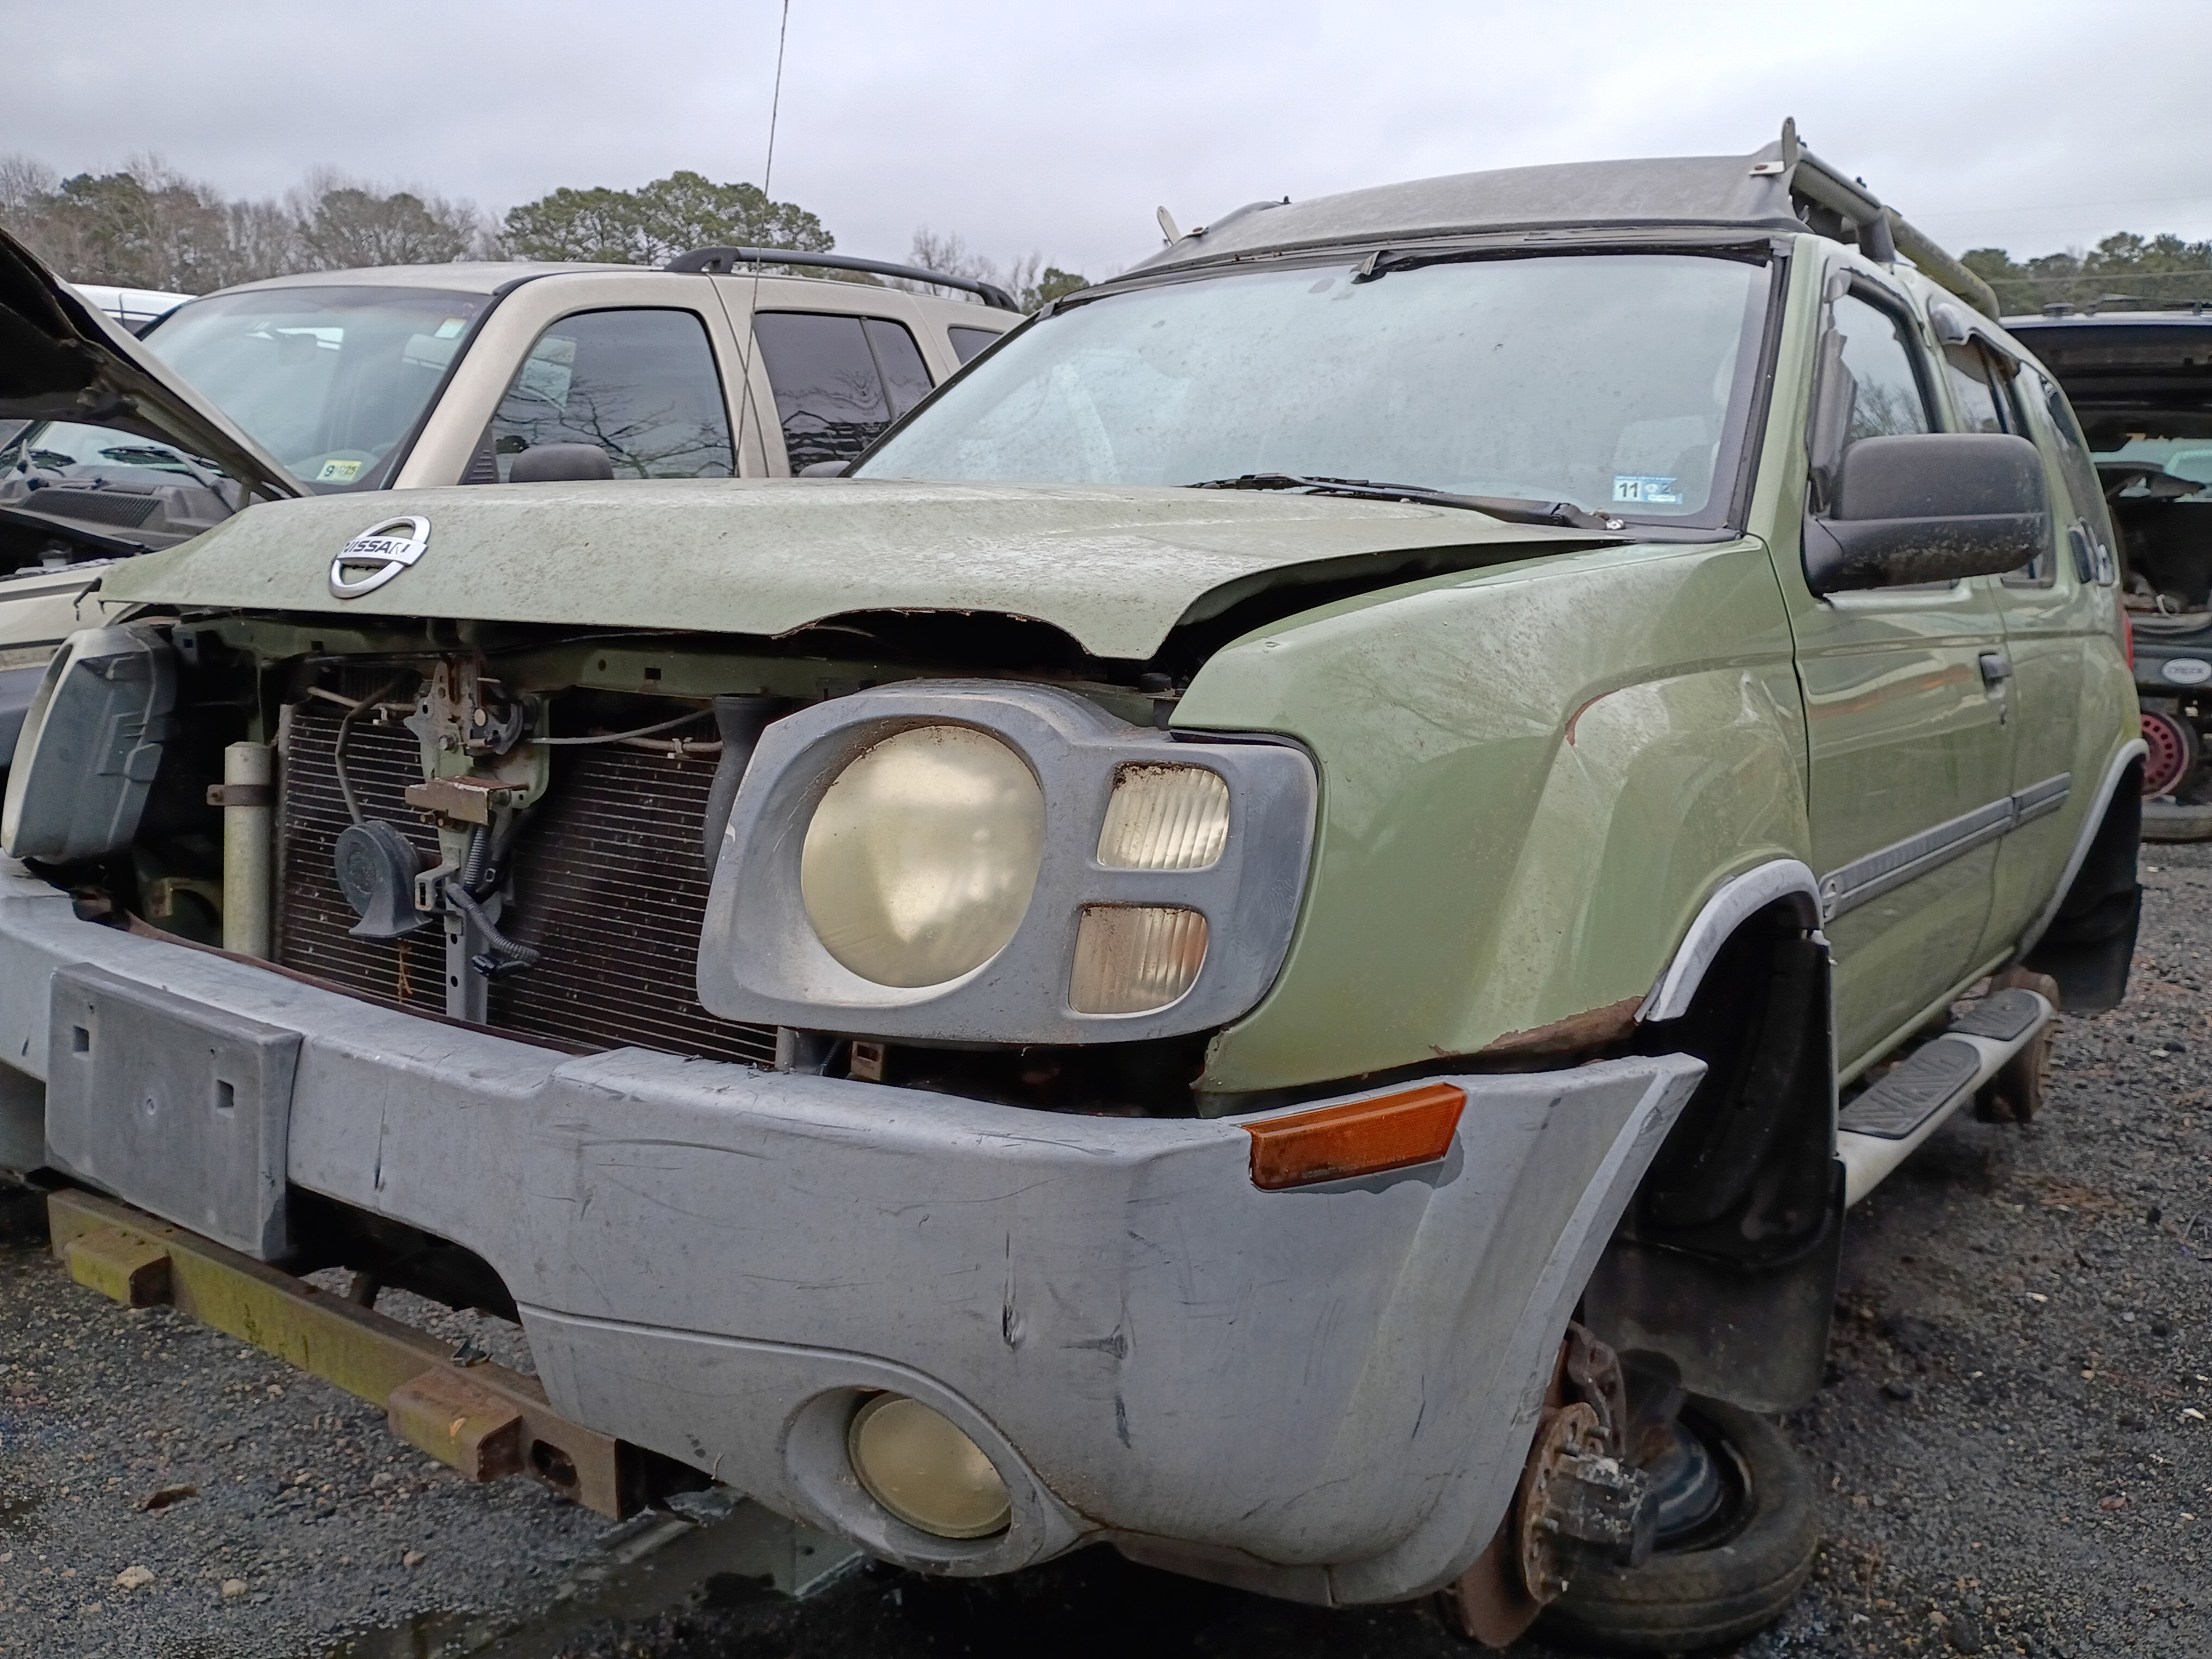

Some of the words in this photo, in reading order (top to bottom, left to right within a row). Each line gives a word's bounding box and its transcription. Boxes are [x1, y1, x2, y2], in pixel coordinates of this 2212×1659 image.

[324, 465, 335, 477] 9
[1619, 483, 1638, 498] 11
[342, 541, 411, 555] NISSAN
